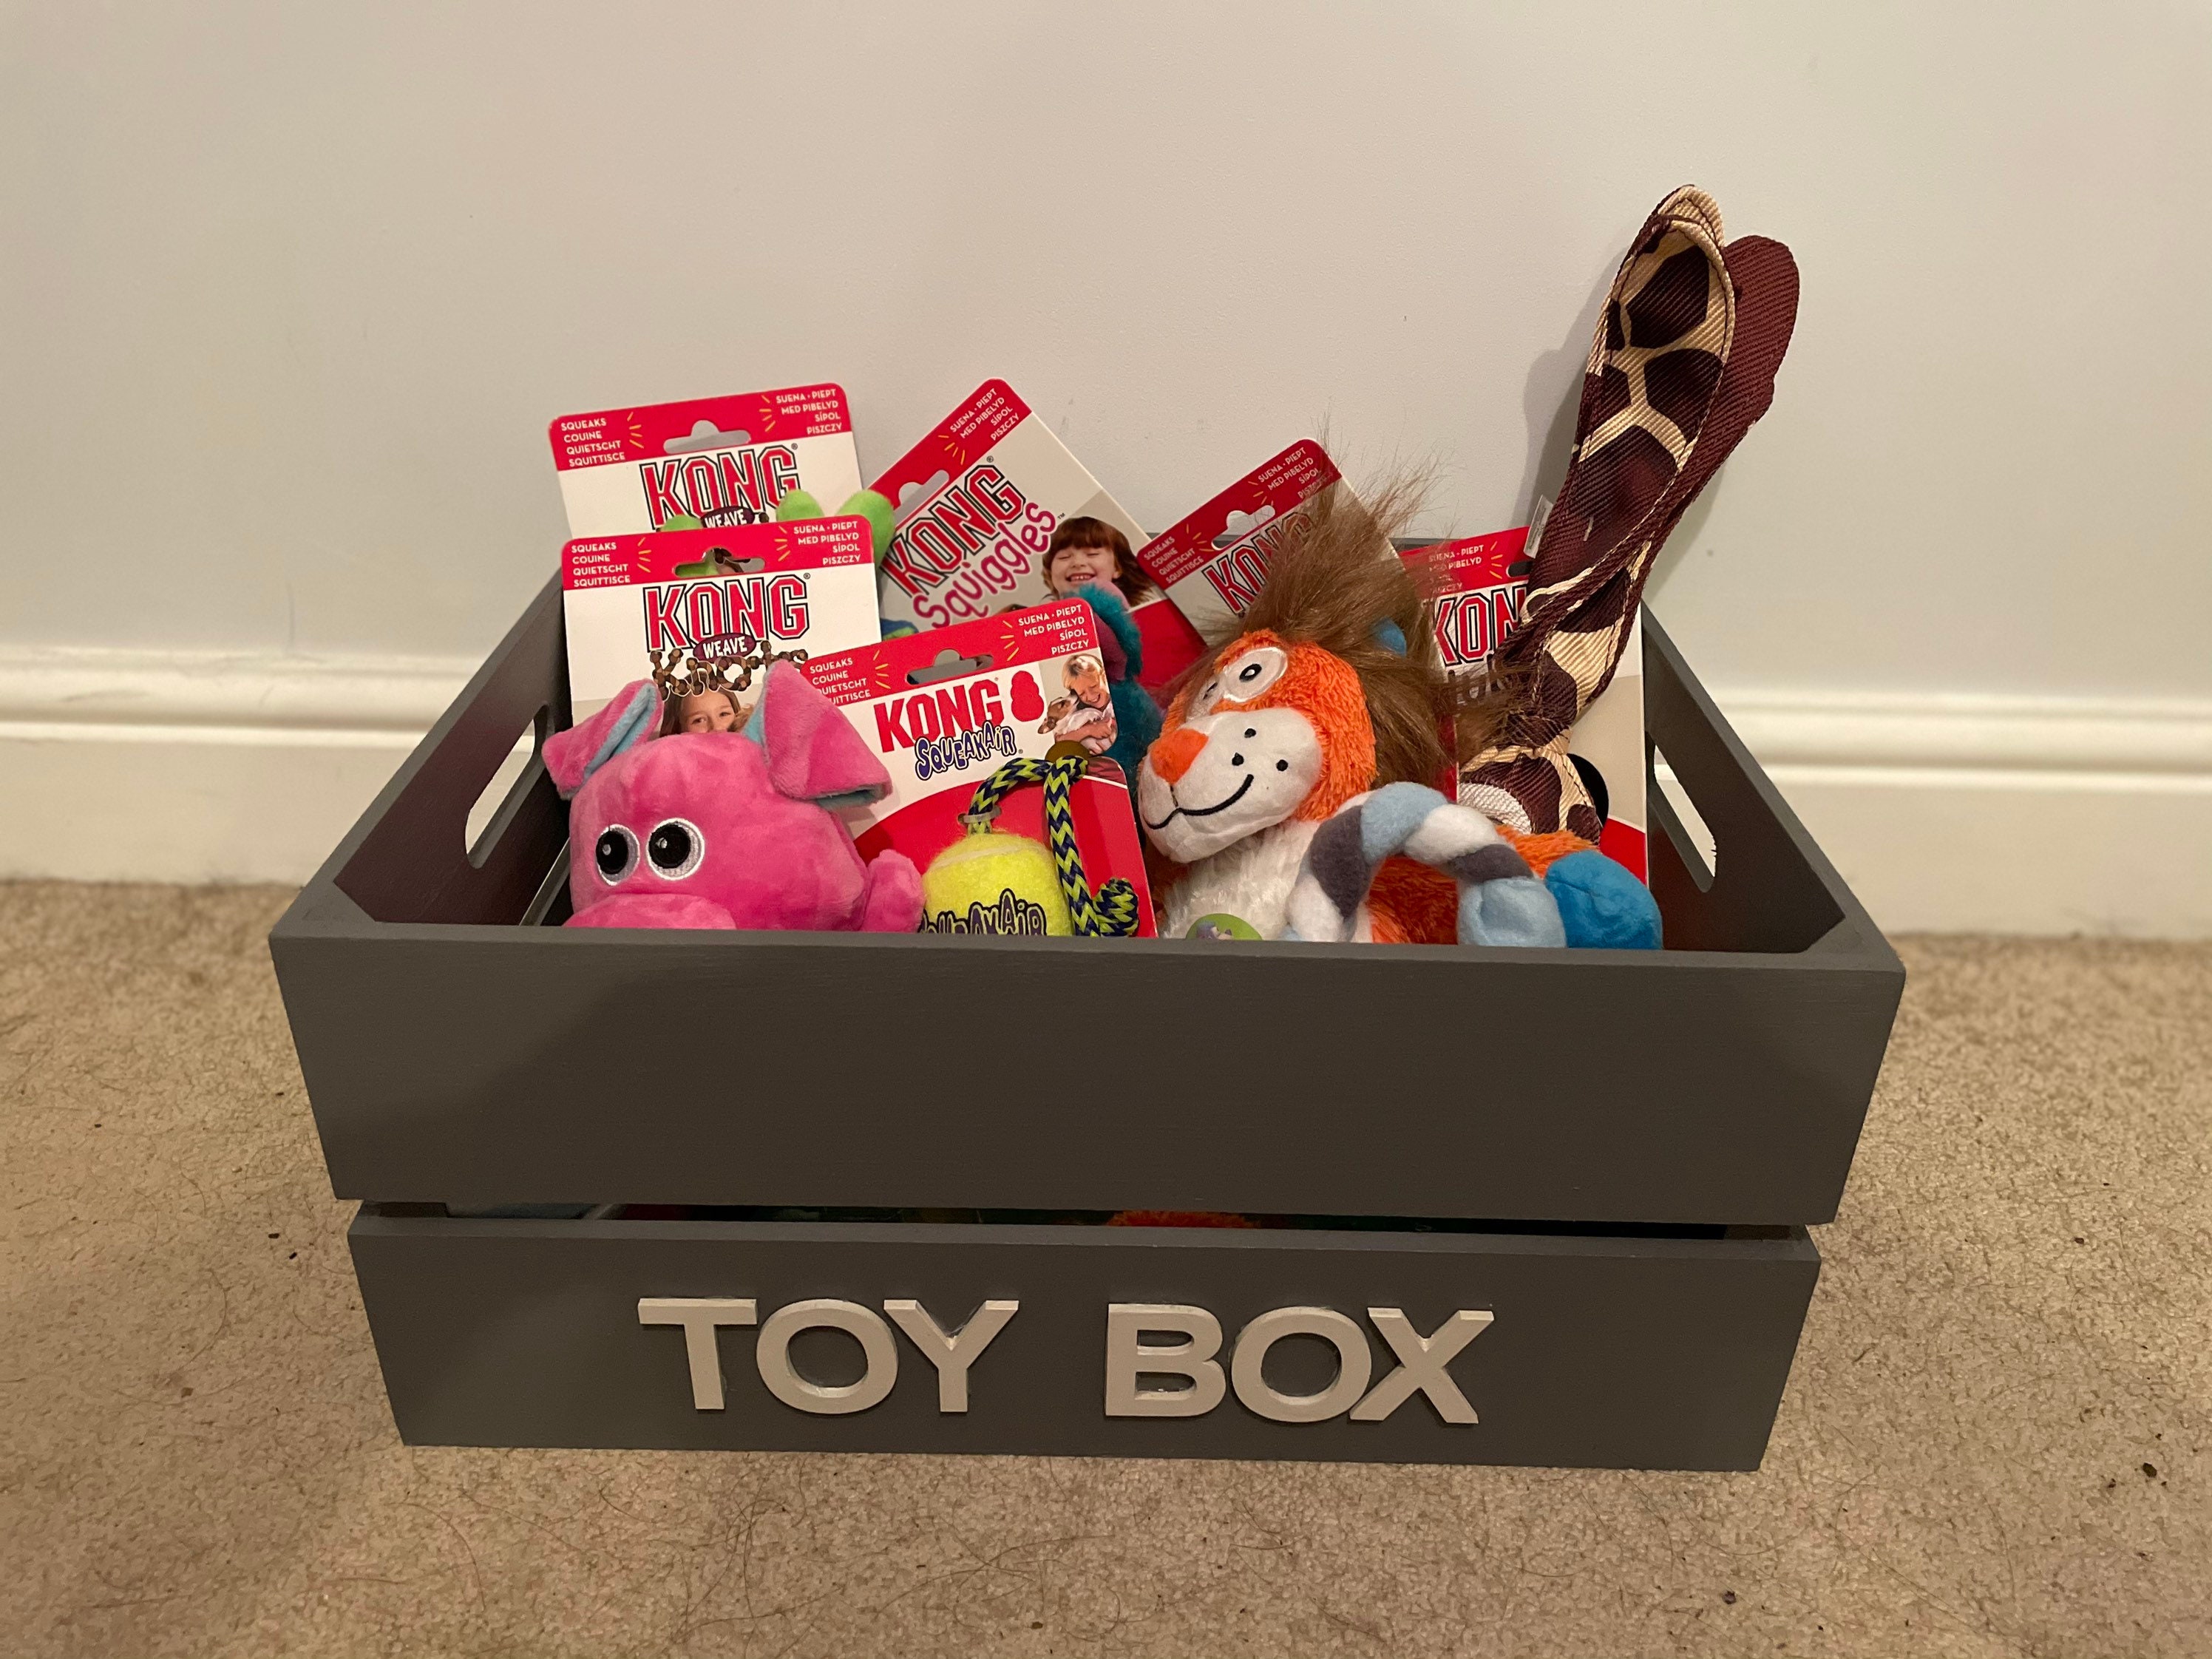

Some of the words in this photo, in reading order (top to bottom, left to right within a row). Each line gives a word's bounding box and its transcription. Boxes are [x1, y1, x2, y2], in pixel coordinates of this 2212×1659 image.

[776, 393, 806, 404] SUENA
[812, 388, 836, 399] PIEPT
[781, 405, 801, 415] MED
[802, 400, 838, 412] PIBELYD
[950, 410, 975, 432] SUENA
[976, 387, 997, 408] PIEPT
[991, 406, 1013, 426] SÍPOL
[560, 417, 607, 431] SQUEAKS
[815, 411, 841, 422] SÍPOL
[960, 422, 977, 439] MED
[975, 397, 1005, 424] PIBELYD
[807, 422, 842, 435] PISZCZY
[991, 413, 1020, 441] PISZCZY
[563, 430, 603, 443] COUINE
[566, 440, 621, 455] QUIETSCHT
[569, 452, 625, 467] SQUITTISCE
[1258, 464, 1283, 483] SUENA
[1285, 447, 1306, 465] PIEPT
[1267, 476, 1284, 491] MED
[1283, 458, 1314, 480] PIBELYD
[639, 444, 801, 530] KONG
[704, 509, 747, 529] WEAVE
[793, 524, 825, 535] SUENA
[832, 520, 858, 531] PIEPT
[798, 536, 818, 545] MED
[821, 532, 859, 543] PIBELYD
[879, 465, 1026, 598] KONG
[571, 542, 617, 554] SQUEAKS
[832, 543, 860, 553] SÍPOL
[1144, 536, 1175, 560] SQUEAKS
[1461, 544, 1484, 556] PIEPT
[572, 554, 611, 565] COUINE
[822, 554, 861, 566] PISZCZY
[912, 502, 1056, 628] Squiggles
[1152, 547, 1178, 568] COUINE
[1158, 547, 1195, 575] QUIETSCHT
[573, 563, 628, 576] QUIETSCHT
[1166, 556, 1204, 583] SQUITTISCE
[573, 574, 631, 588] SQUITTISCE
[642, 574, 810, 653] KONG
[1018, 613, 1050, 626] SUENA
[1056, 605, 1082, 617] PIEPT
[1024, 625, 1045, 637] MED
[1046, 617, 1085, 632] PIBELYD
[1434, 583, 1528, 667] KON
[1059, 628, 1088, 641] SÍPOL
[703, 636, 747, 659] WEAVE
[1051, 639, 1089, 655] PISZCZY
[810, 657, 853, 674] SQUEAKS
[812, 670, 849, 685] COUINE
[829, 689, 871, 705] UITTISCE
[873, 679, 1004, 753] KONG
[637, 1297, 1020, 1415] TOY
[1105, 1303, 1495, 1424] BOX
